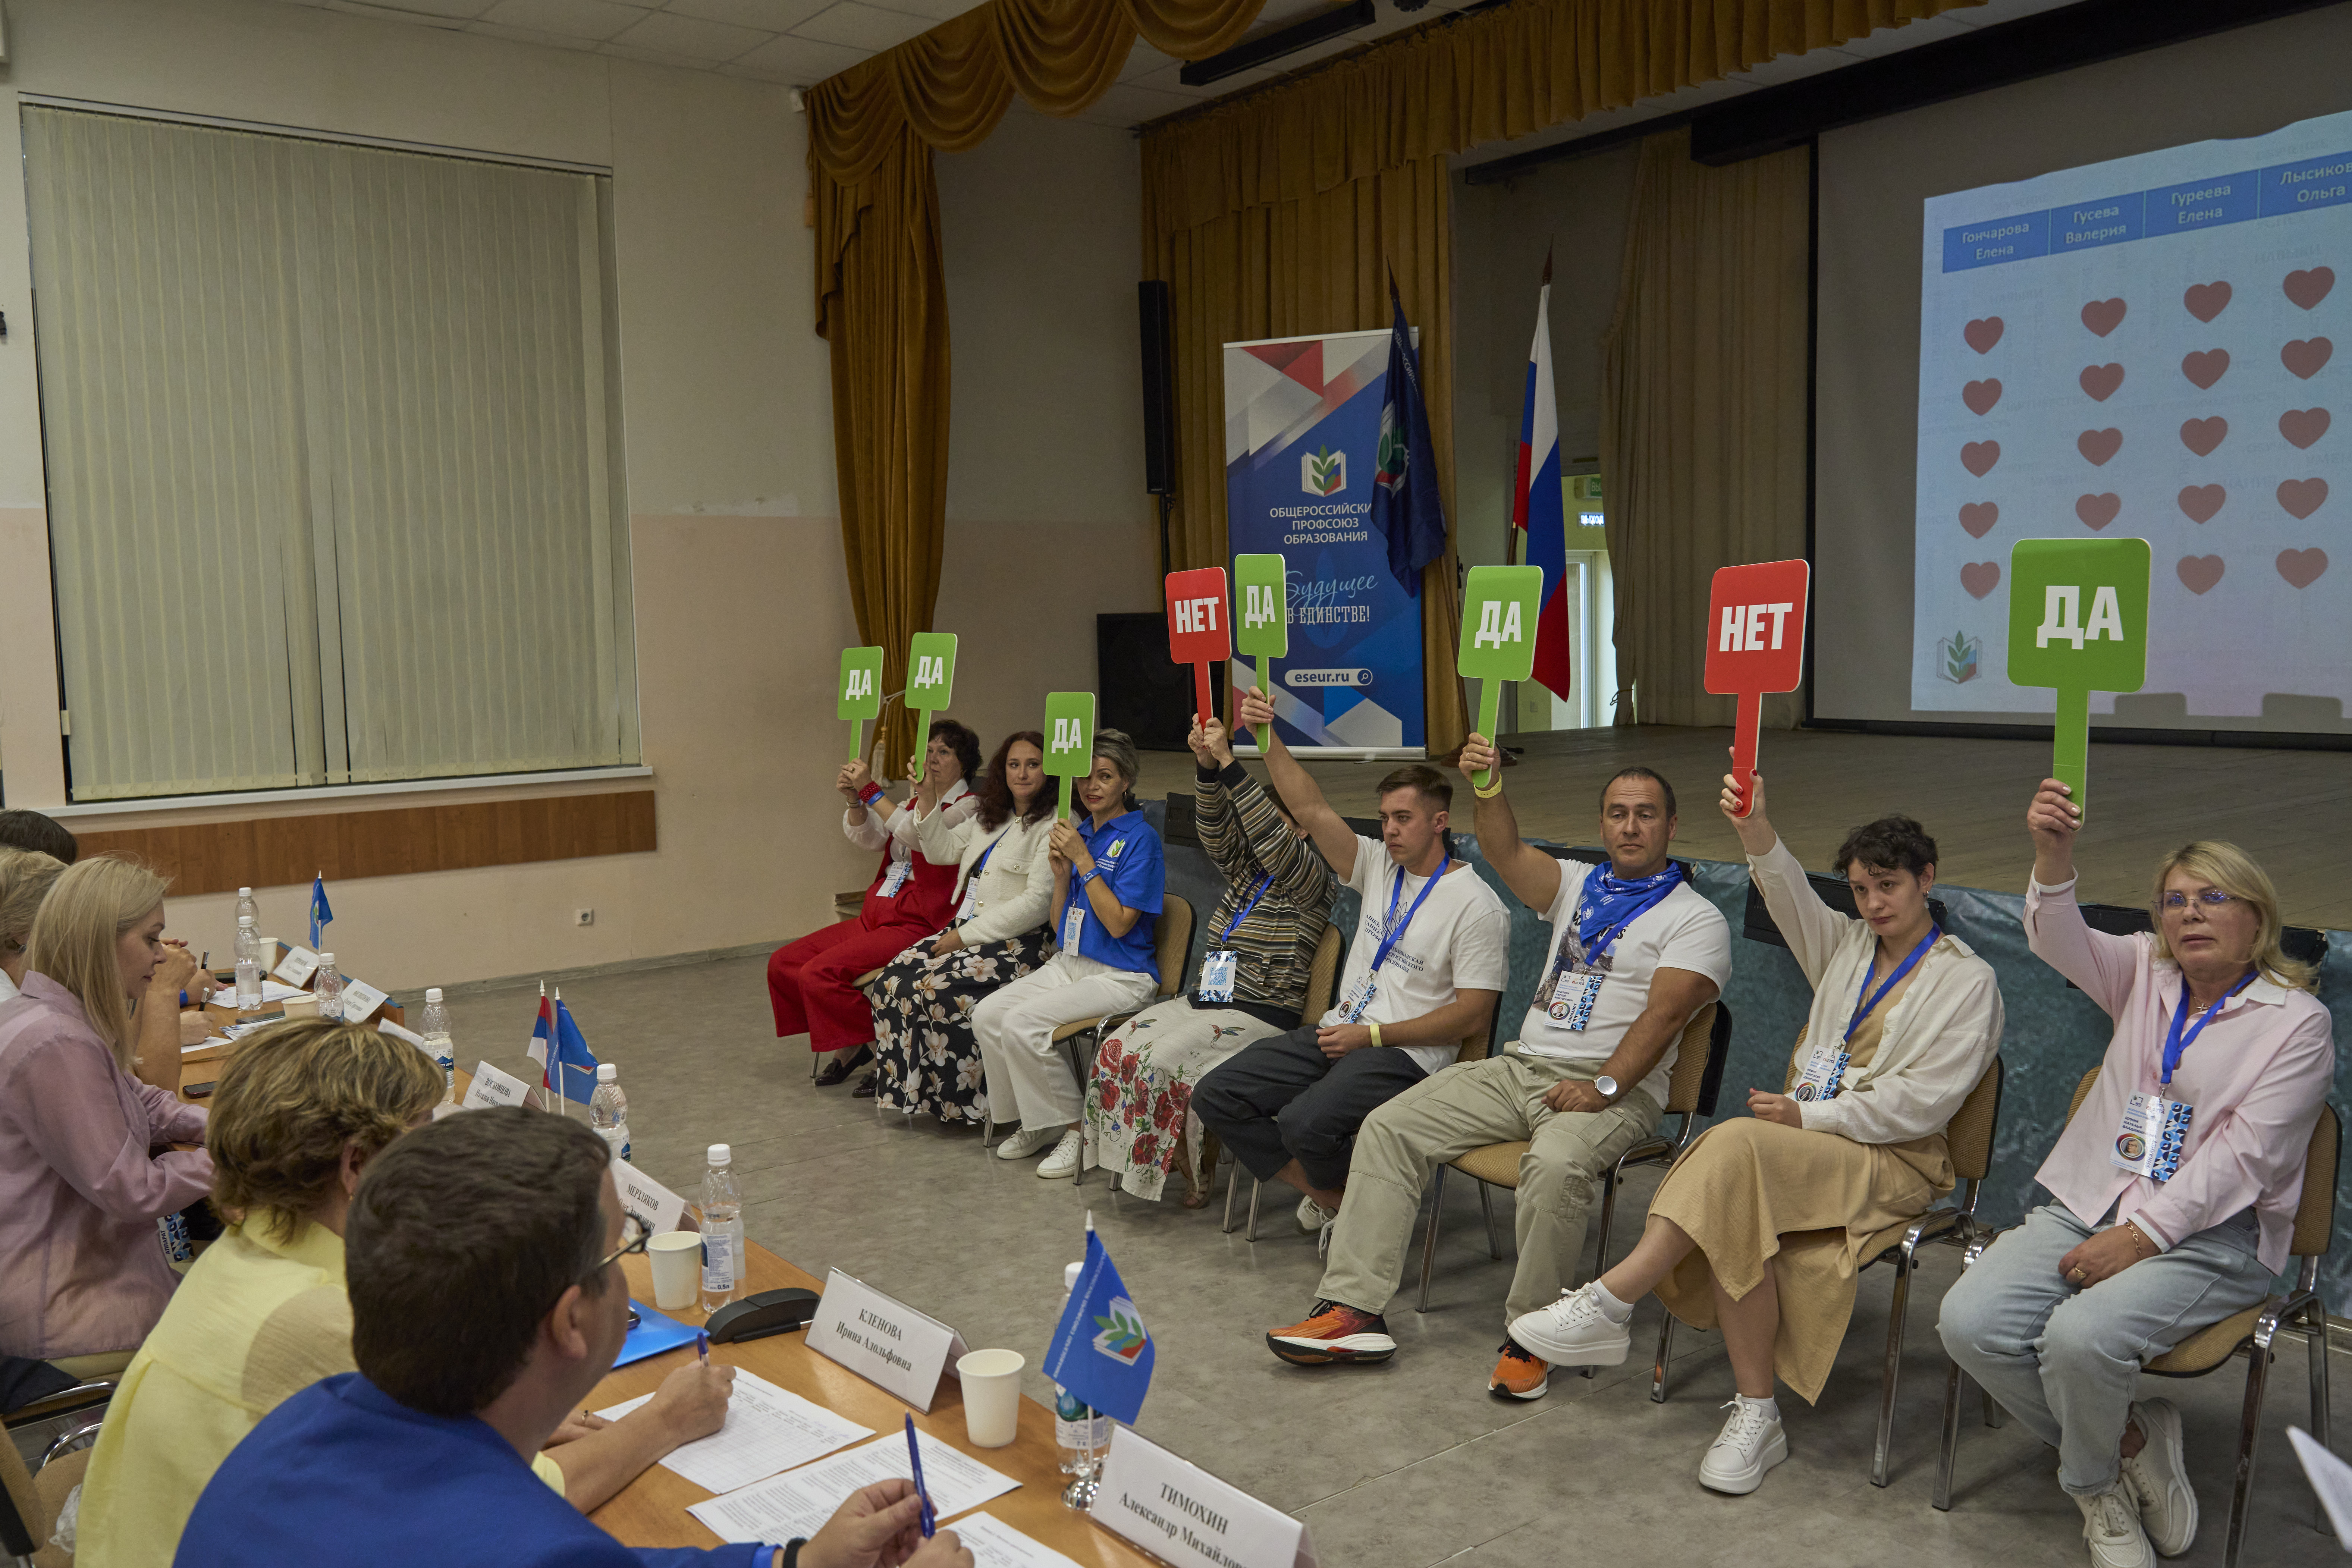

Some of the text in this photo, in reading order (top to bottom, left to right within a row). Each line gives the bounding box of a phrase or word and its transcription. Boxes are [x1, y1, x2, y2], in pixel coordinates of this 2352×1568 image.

[2280, 162, 2352, 185] Лысиков
[2171, 184, 2231, 206] Гуреева
[2297, 186, 2346, 202] Ольга
[2074, 207, 2119, 224] Гусева
[2178, 208, 2222, 224] Елена
[1962, 223, 2029, 243] Гончарова
[2066, 225, 2126, 244] Валерия
[1976, 245, 2013, 260] Елена
[1270, 503, 1372, 518] ОБЩЕРОССИЙСКИ
[1293, 518, 1359, 530] ПРОФСОЮЗ
[1284, 531, 1367, 544] ОБРАЗОВАНИЯ
[1175, 597, 1219, 633] НЕТ
[1245, 585, 1275, 628] ДА
[1299, 606, 1370, 625] ЕДИНСТВЕ!
[1475, 601, 1521, 649] ДА
[1720, 603, 1793, 651] НЕТ
[2037, 585, 2124, 649] ДА
[914, 656, 942, 688] ДА
[1295, 672, 1349, 684] eseur.ru
[845, 670, 871, 700] ДА
[1052, 719, 1081, 754] ДА
[1385, 957, 1409, 973] РАЗОВАНИЯ
[1387, 952, 1423, 971] ЕРОССИЙСКОГО
[1568, 1003, 1577, 1023] ФИНАЛИСТ
[475, 1089, 489, 1104] Наталья
[485, 1078, 511, 1097] ВОСКОВЦОВА
[1815, 1085, 1824, 1101] АЛИСТ
[2123, 1121, 2142, 1129] НАТАЛЬЯ
[627, 1184, 659, 1210] МЕРЗЛЯКОВ
[161, 1231, 170, 1254] АППАРАТ
[859, 1308, 902, 1341] КЛЕНОВА
[836, 1321, 911, 1371] Ирина Адольфовна
[1119, 1492, 1178, 1539] Александр
[1161, 1482, 1228, 1535] ТИМОХИН
